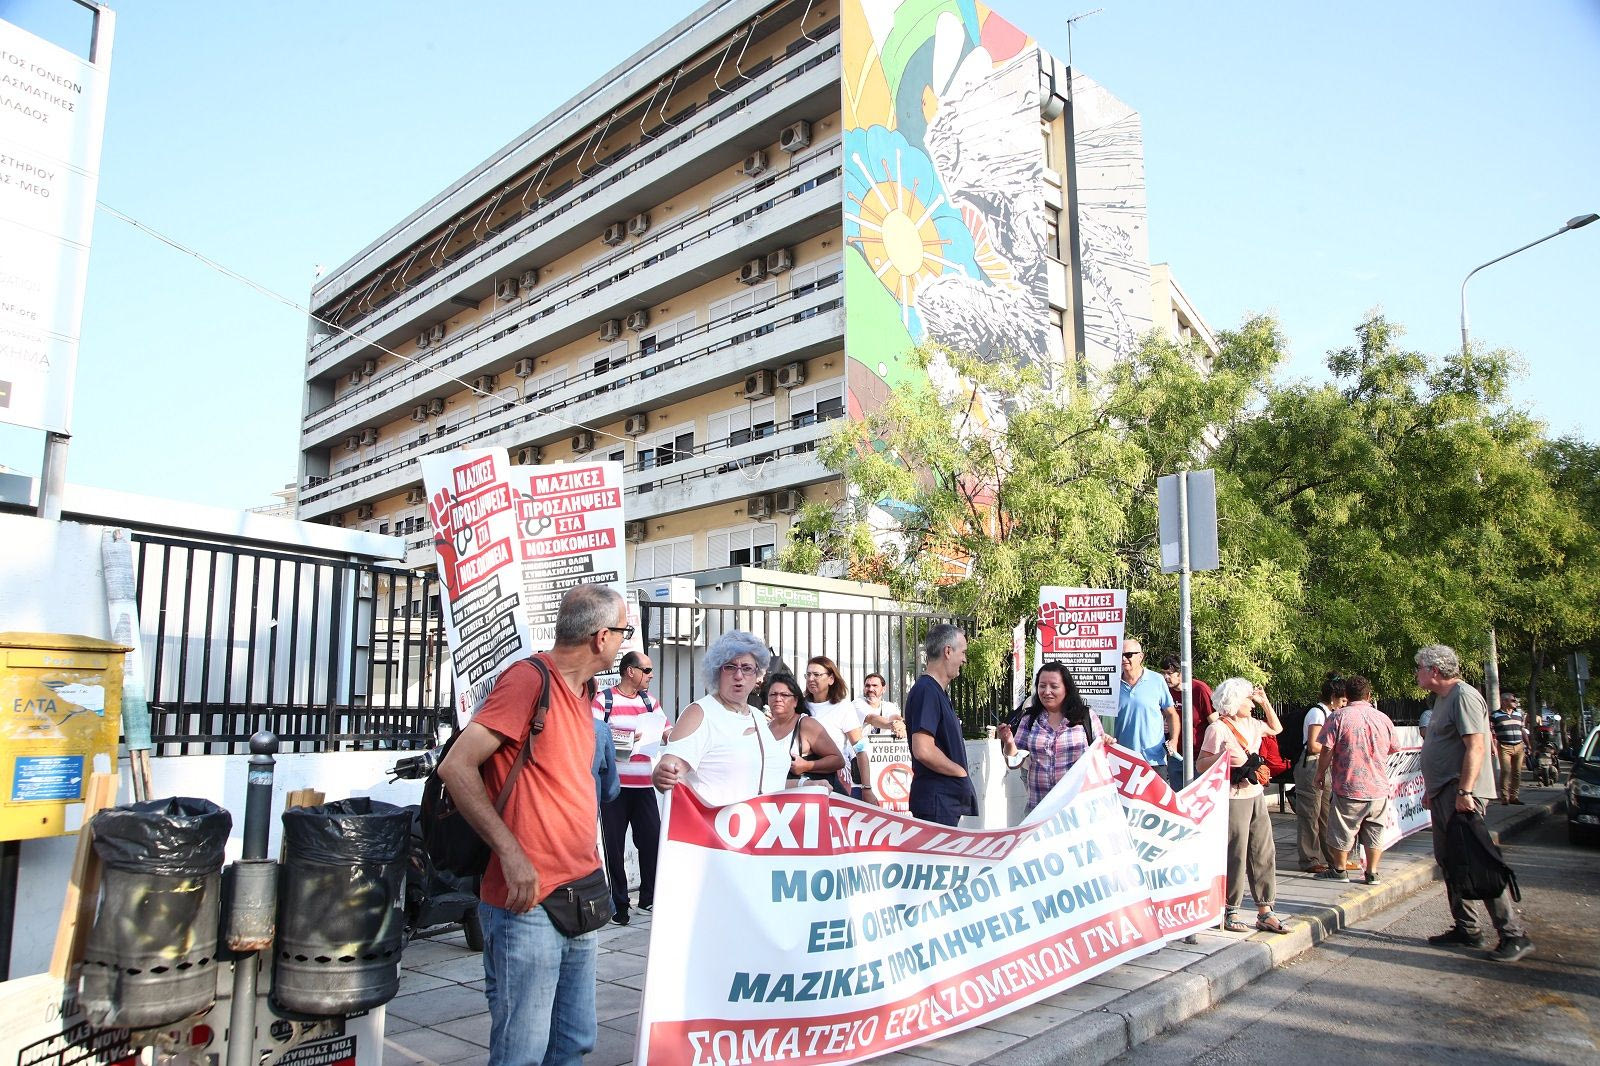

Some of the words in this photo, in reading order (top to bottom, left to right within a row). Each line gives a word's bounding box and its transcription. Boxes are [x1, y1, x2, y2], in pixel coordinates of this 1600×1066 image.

[0, 50, 25, 68] ΓΟΣ
[30, 64, 82, 94] ΓΟΝΕΩΝ
[0, 73, 75, 112] ΑΣΜΑΤΙΚΕΣ
[456, 461, 494, 494] ΜΑΖΙΚΕΣ
[536, 469, 601, 493] ΜΑΖΙΚΕΣ
[452, 488, 509, 527] ΠΡΟΣΛΗΨΕΙΣ
[523, 490, 616, 518] ΠΡΟΣΛΗΨΕΙΣ
[559, 516, 581, 532] ΣΤΑ
[526, 531, 610, 557] ΝΟΣΟΚΟΜΕΙΑ
[1068, 595, 1112, 608] ΜΑΖΙΚΕΣ
[1058, 610, 1121, 624] ΠΡΟΣΛΗΨΕΙΣ
[1080, 625, 1097, 635] ΣΤΑ
[1058, 637, 1114, 650] ΝΟΣΟΚΟΜΕΙΑ
[870, 754, 912, 763] ΔΟΛΟΦΟΝ
[872, 745, 909, 754] ΚΥΒΕΡΝ
[715, 802, 820, 850] ΟΧΙ
[880, 873, 1001, 937] ΕΡΓΟΛΑΒΟΙ
[1007, 852, 1065, 893] ΑΠΟ
[1068, 839, 1104, 868] ΤΑ
[727, 959, 885, 1003] ΜΑΖΙΚΕΣ
[887, 905, 1031, 985] ΠΡΟΣΛΗΨΕΙΣ
[1031, 863, 1145, 925] ΜΟΝΙΜΟ
[687, 1014, 880, 1066] ΣΩΜΑΤΕΙΟ
[884, 938, 1081, 1040] ΕΡΓΑΖΟΜΕΝΩΝ
[1081, 915, 1142, 960] ΓΝΑ
[277, 1044, 329, 1064] ΣΥΜΒΑΣΙ
